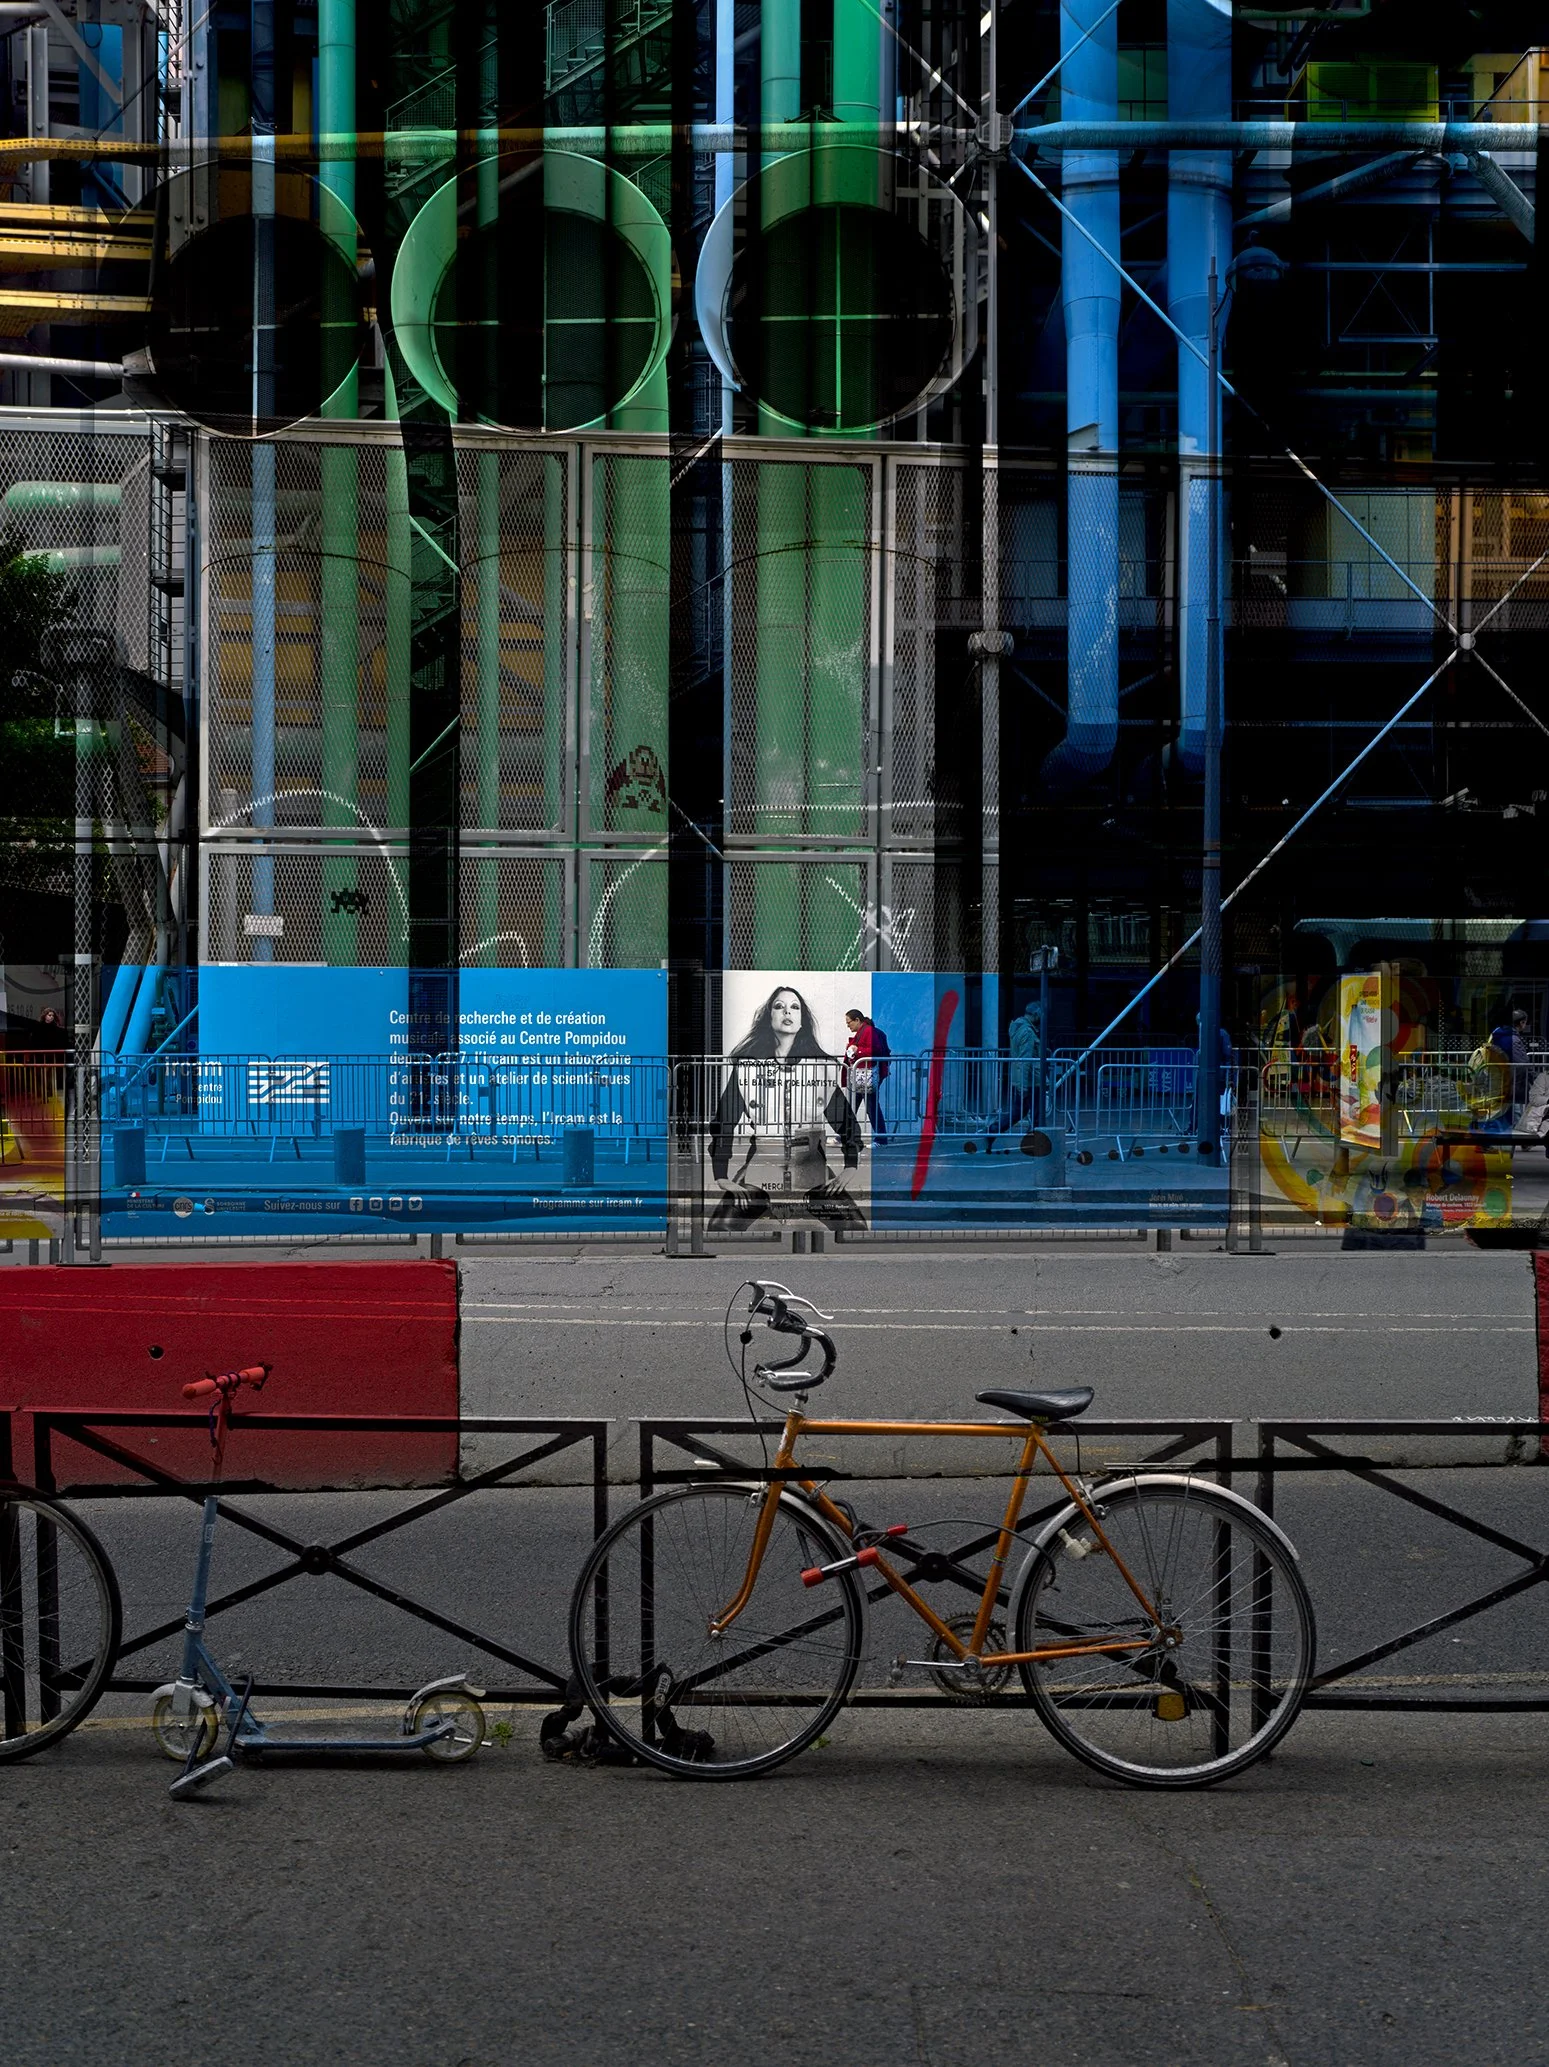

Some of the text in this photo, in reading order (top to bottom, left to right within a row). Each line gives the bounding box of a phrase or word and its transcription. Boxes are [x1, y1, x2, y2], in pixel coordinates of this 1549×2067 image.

[390, 1010, 606, 1025] Centre de recherche et de création
[450, 1031, 497, 1045] associé
[500, 1034, 516, 1045] au
[519, 1031, 561, 1045] Centre
[565, 1031, 627, 1048] Pompidou
[522, 1053, 541, 1065] est
[545, 1055, 561, 1065] un
[565, 1051, 632, 1065] laboratoire
[164, 1056, 222, 1077] ircam
[453, 1072, 466, 1085] et
[469, 1074, 485, 1085] un
[488, 1071, 529, 1085] atelier
[532, 1071, 548, 1085] de
[552, 1071, 631, 1088] scientifiques
[192, 1082, 223, 1092] entre
[390, 1092, 405, 1105] du
[459, 1112, 492, 1126] notre
[496, 1112, 538, 1129] temps,
[589, 1112, 608, 1125] est
[612, 1111, 623, 1125] la
[389, 1131, 555, 1149] fabrique de rêves sonores.
[761, 1182, 784, 1191] MERCI
[264, 1199, 341, 1211] Suivez-nous sur
[533, 1197, 643, 1210] Programme sur ircam.fr
